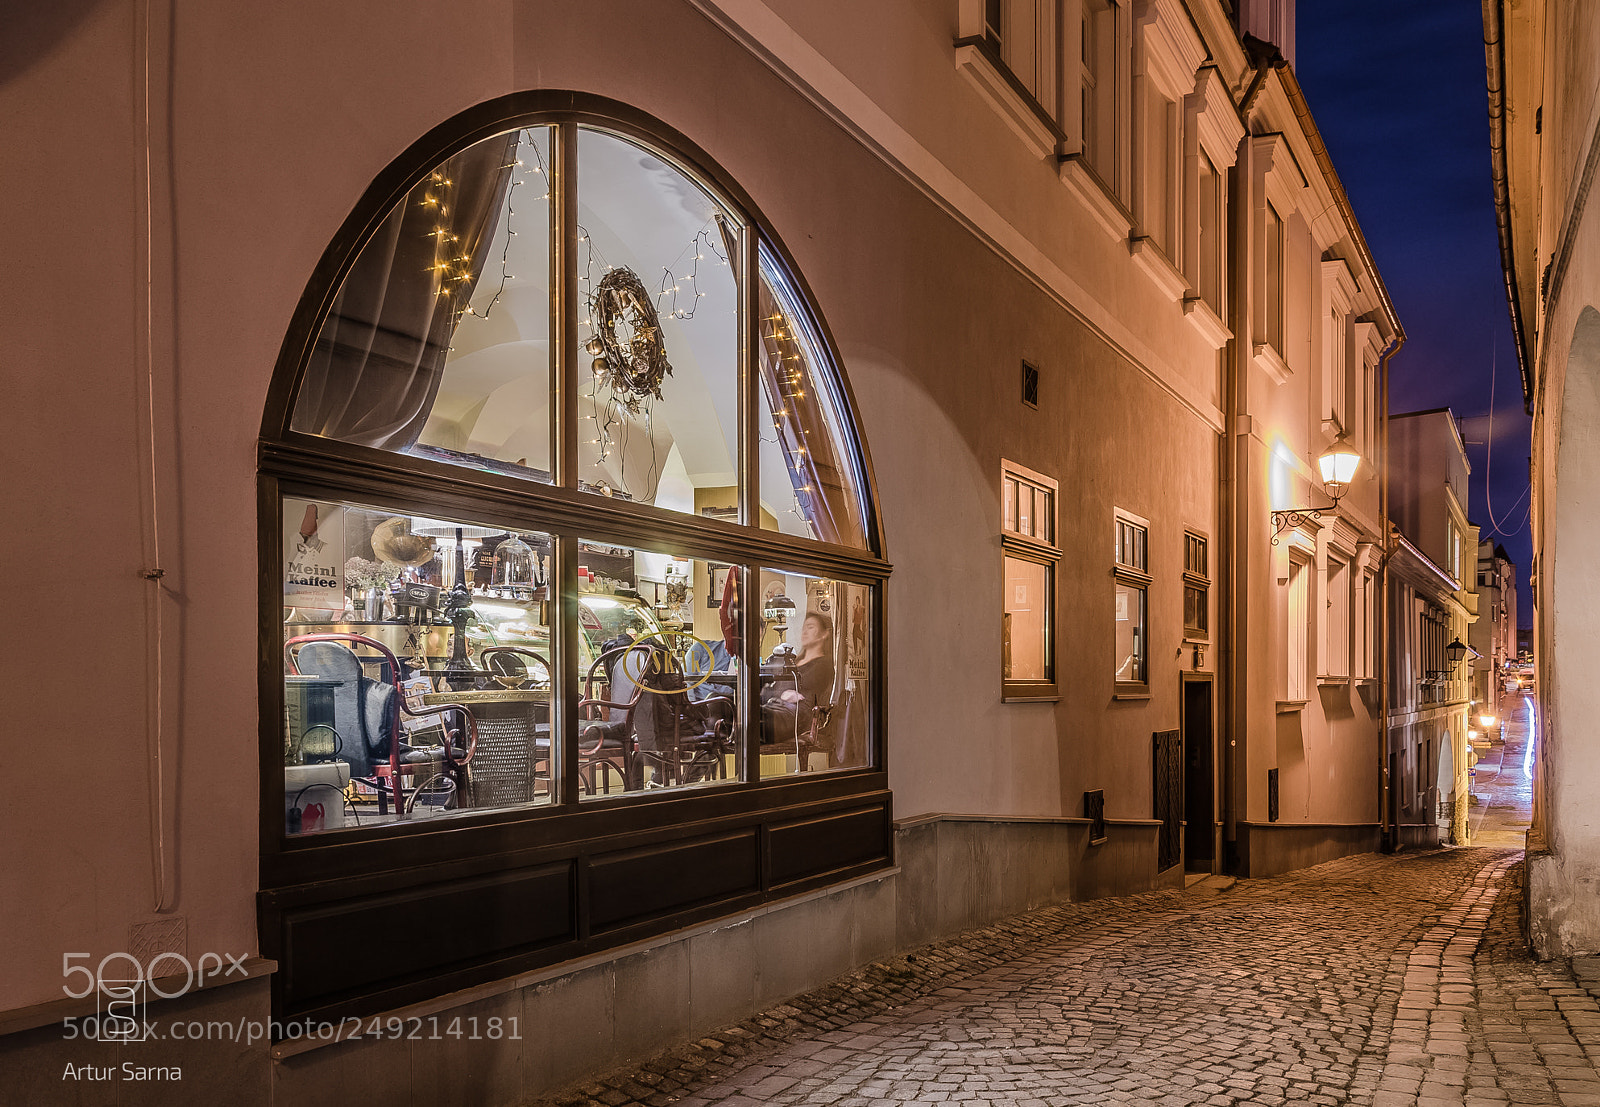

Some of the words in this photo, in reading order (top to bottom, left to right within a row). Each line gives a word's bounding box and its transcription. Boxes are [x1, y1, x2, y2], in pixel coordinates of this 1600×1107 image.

[288, 561, 336, 577] Meinl
[288, 574, 337, 588] Kaffee
[636, 650, 701, 675] OSKAR
